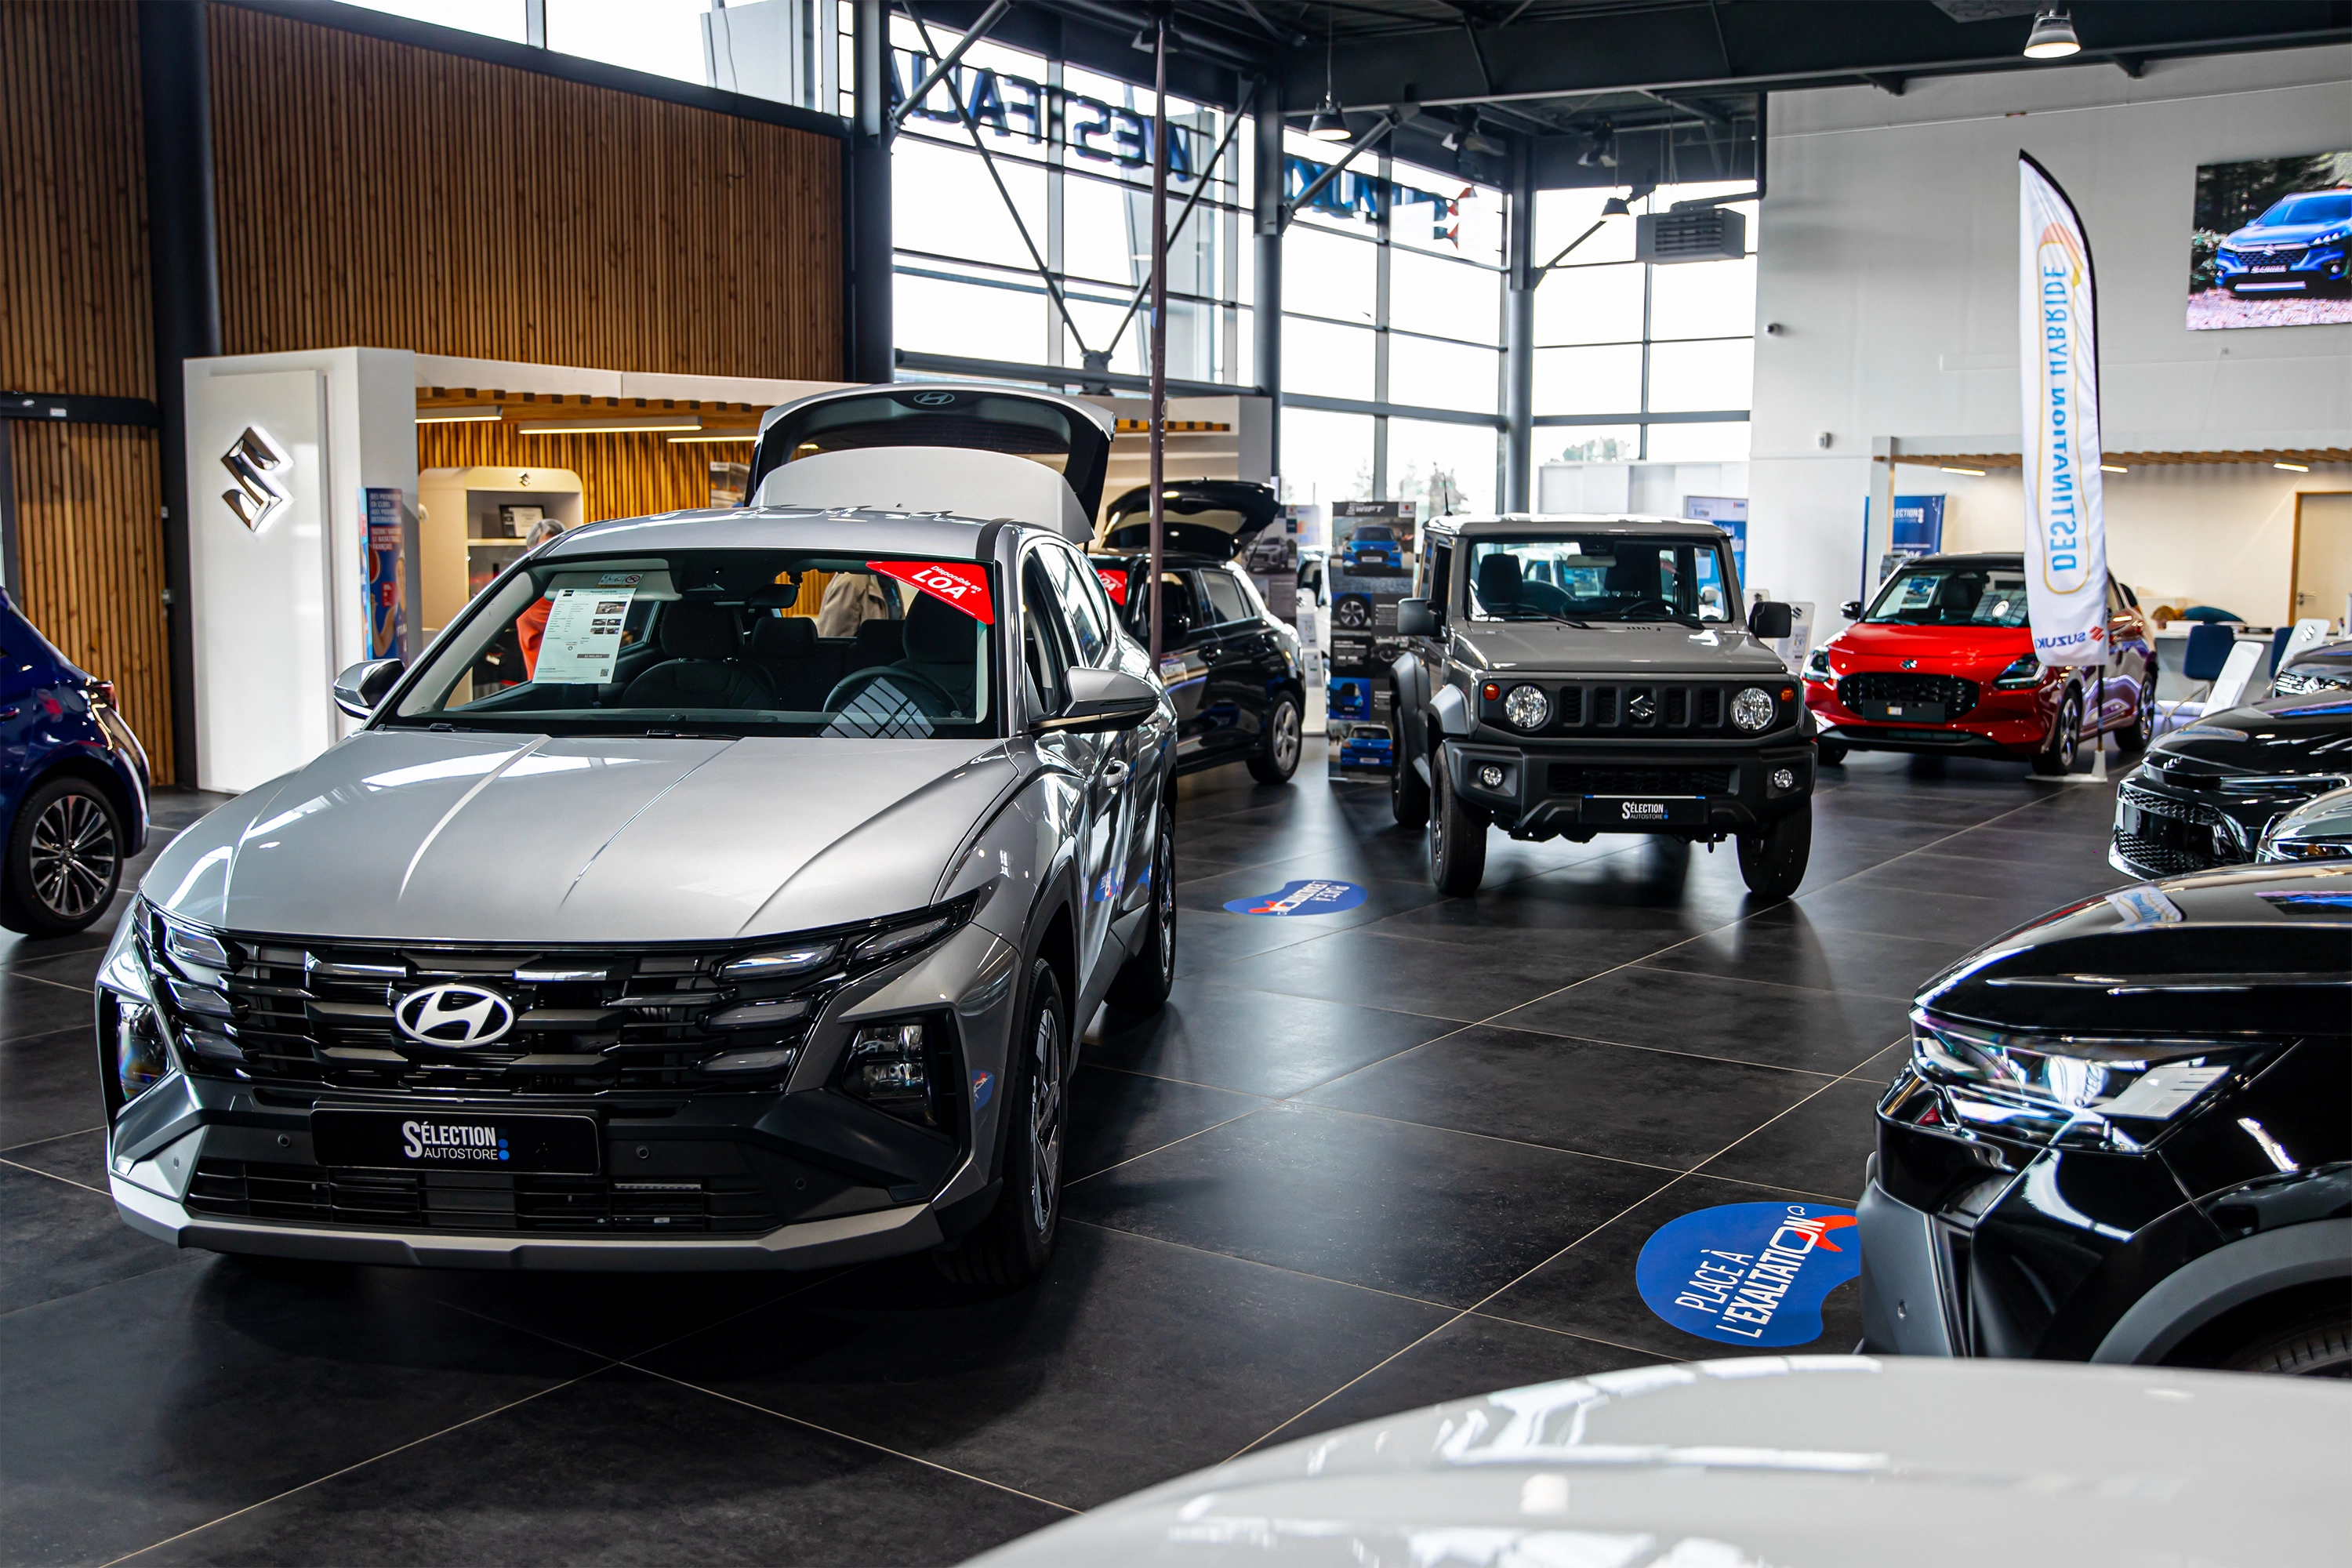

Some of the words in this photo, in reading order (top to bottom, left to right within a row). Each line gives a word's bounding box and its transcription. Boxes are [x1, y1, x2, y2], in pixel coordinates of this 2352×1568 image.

[931, 565, 971, 586] Disponible
[1621, 801, 1664, 820] SÉLECTION
[402, 1120, 496, 1159] SÉLECTION
[424, 1148, 499, 1160] AUTOSTORE
[1700, 1249, 1754, 1266] À
[1674, 1261, 1744, 1314] PLACE
[1715, 1216, 1826, 1338] L'EXALTATION
